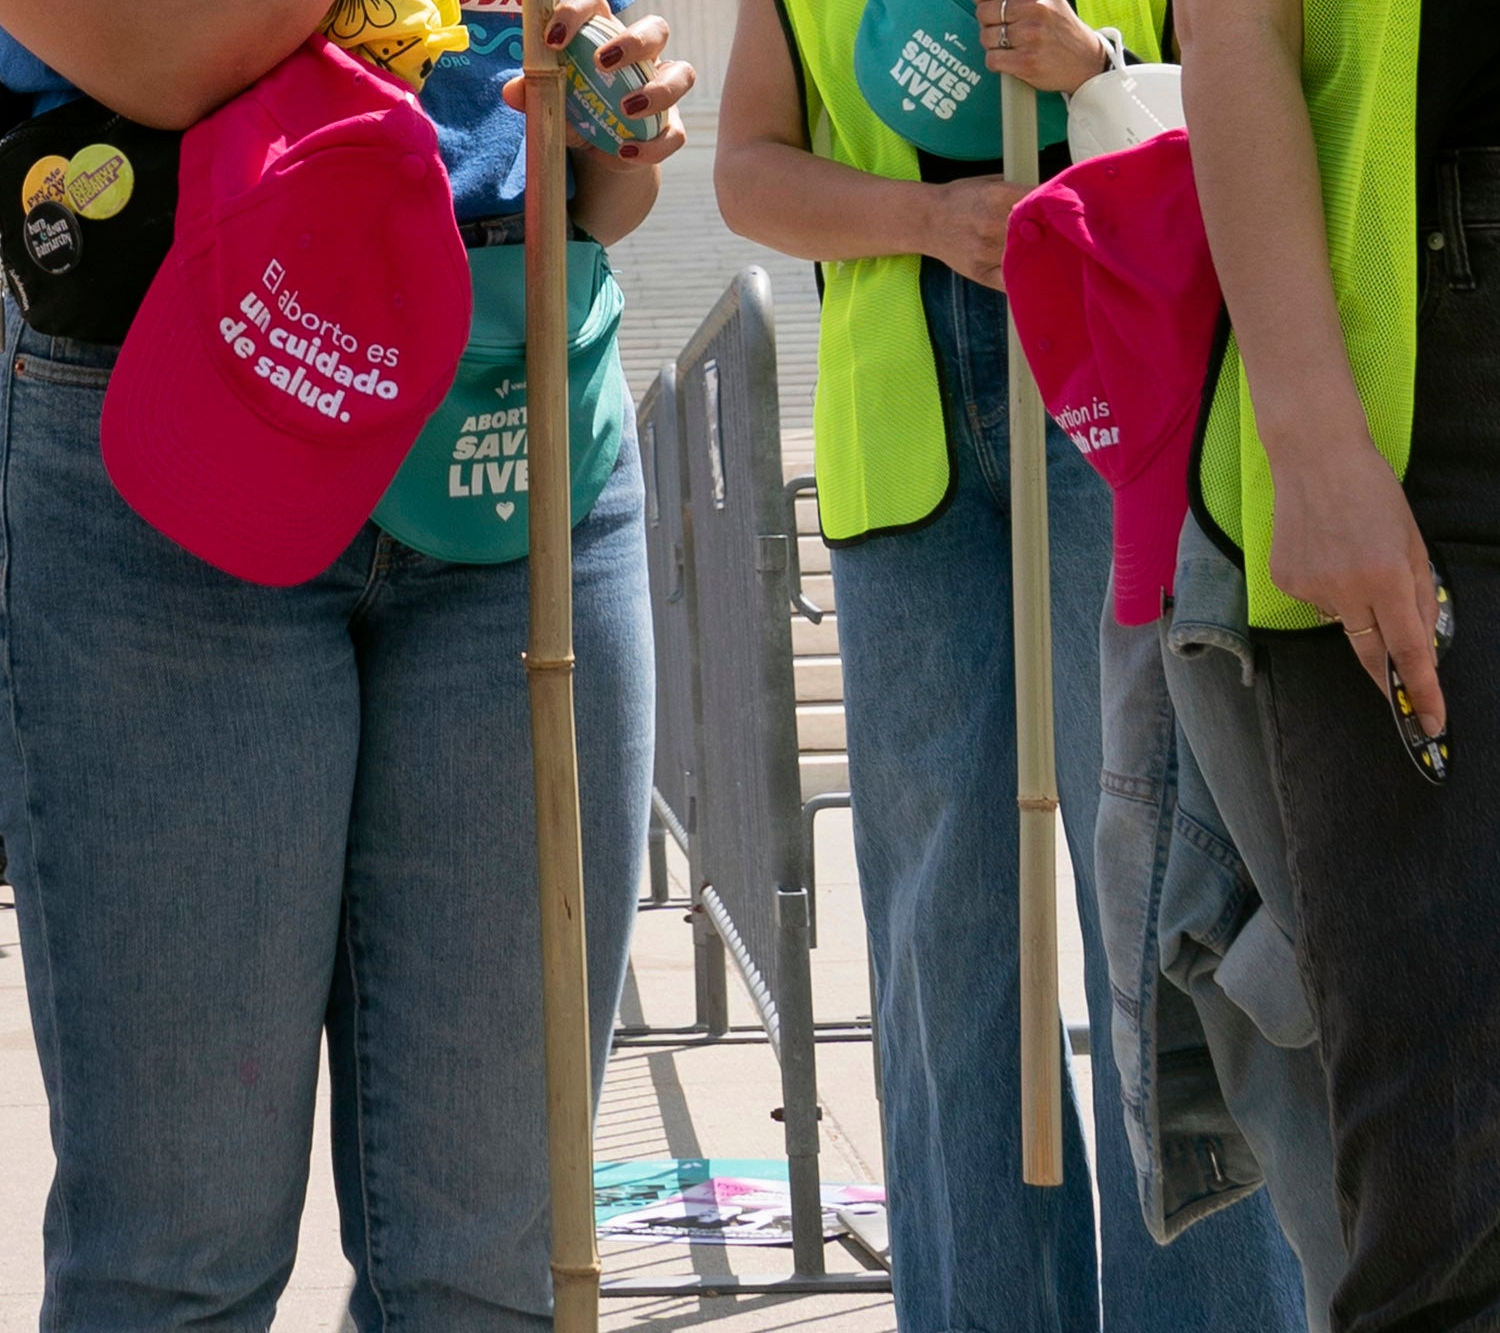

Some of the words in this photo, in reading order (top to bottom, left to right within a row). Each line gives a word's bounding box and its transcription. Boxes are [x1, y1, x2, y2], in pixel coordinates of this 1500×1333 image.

[437, 53, 471, 69] .ORG
[902, 40, 972, 103] SAVES
[913, 28, 982, 86] ABORTION
[566, 64, 635, 139] ALWAY
[572, 89, 624, 145] BORTION
[889, 57, 958, 121] LIVES
[262, 258, 286, 294] El
[278, 289, 358, 353] aborto
[366, 343, 400, 367] es
[219, 317, 256, 359] de
[254, 355, 350, 423] salud.
[240, 291, 272, 333] un
[269, 327, 399, 400] cuidado
[1055, 405, 1091, 430] ortion
[1092, 396, 1110, 420] is
[1089, 426, 1119, 450] Car
[452, 428, 528, 460] SAV
[449, 459, 528, 497] LIVE
